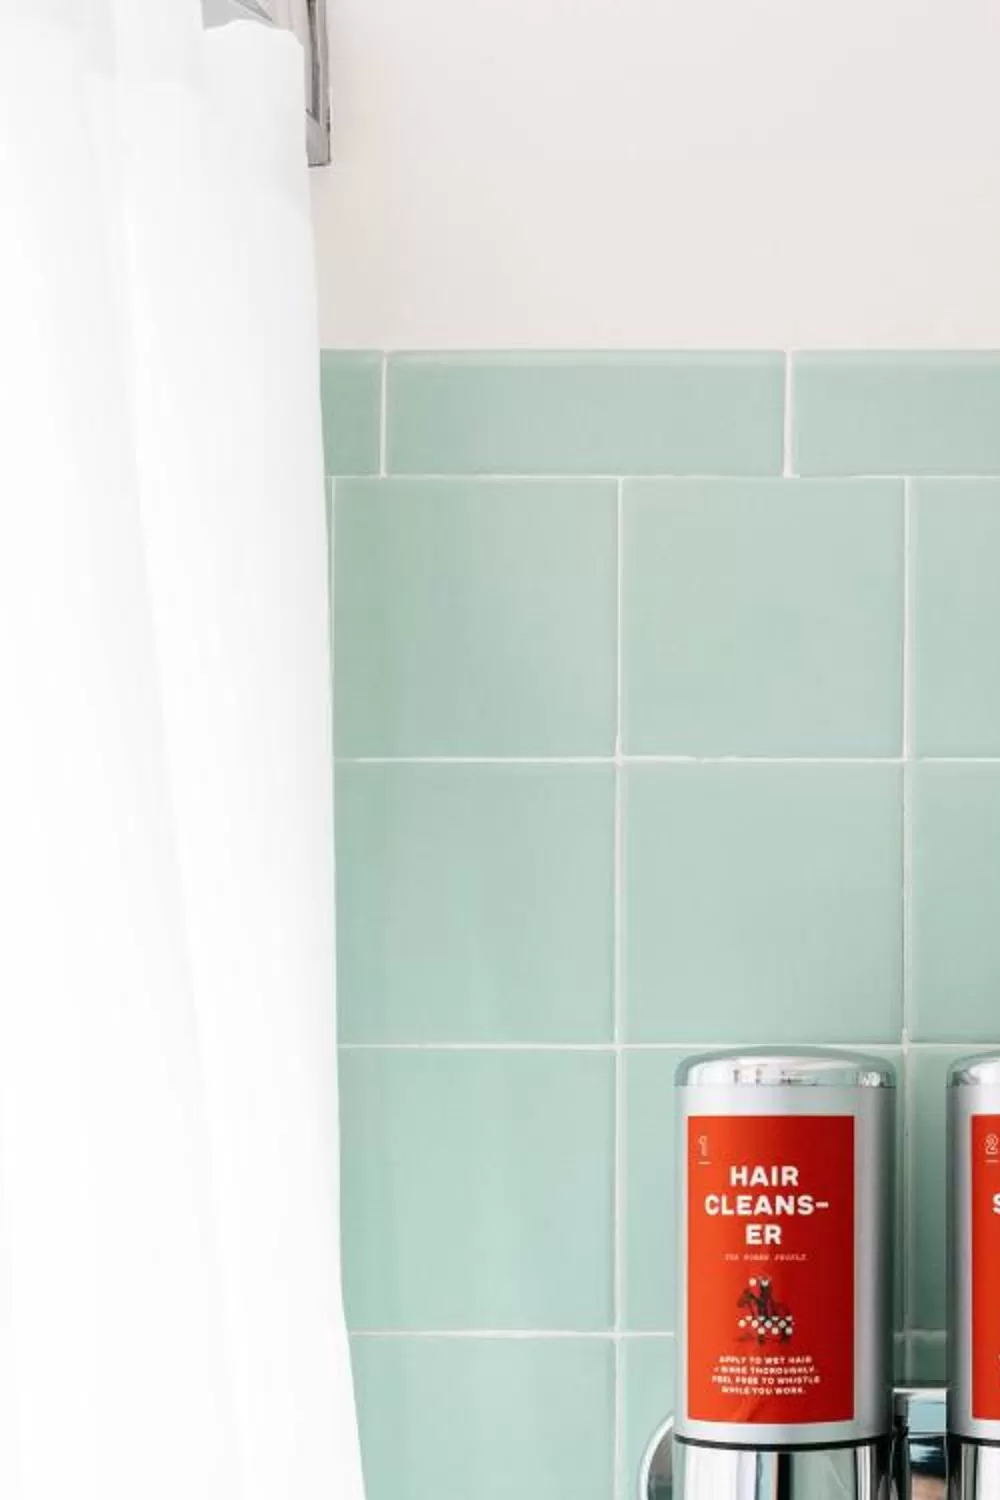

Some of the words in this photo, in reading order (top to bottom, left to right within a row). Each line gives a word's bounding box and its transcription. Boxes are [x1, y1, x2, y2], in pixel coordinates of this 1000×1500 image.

[985, 1133, 999, 1155] 2
[730, 1165, 799, 1187] HAIR
[704, 1194, 829, 1216] CLEANS-
[745, 1223, 782, 1245] ER
[751, 1386, 772, 1395] YOU
[762, 1376, 775, 1385] TO
